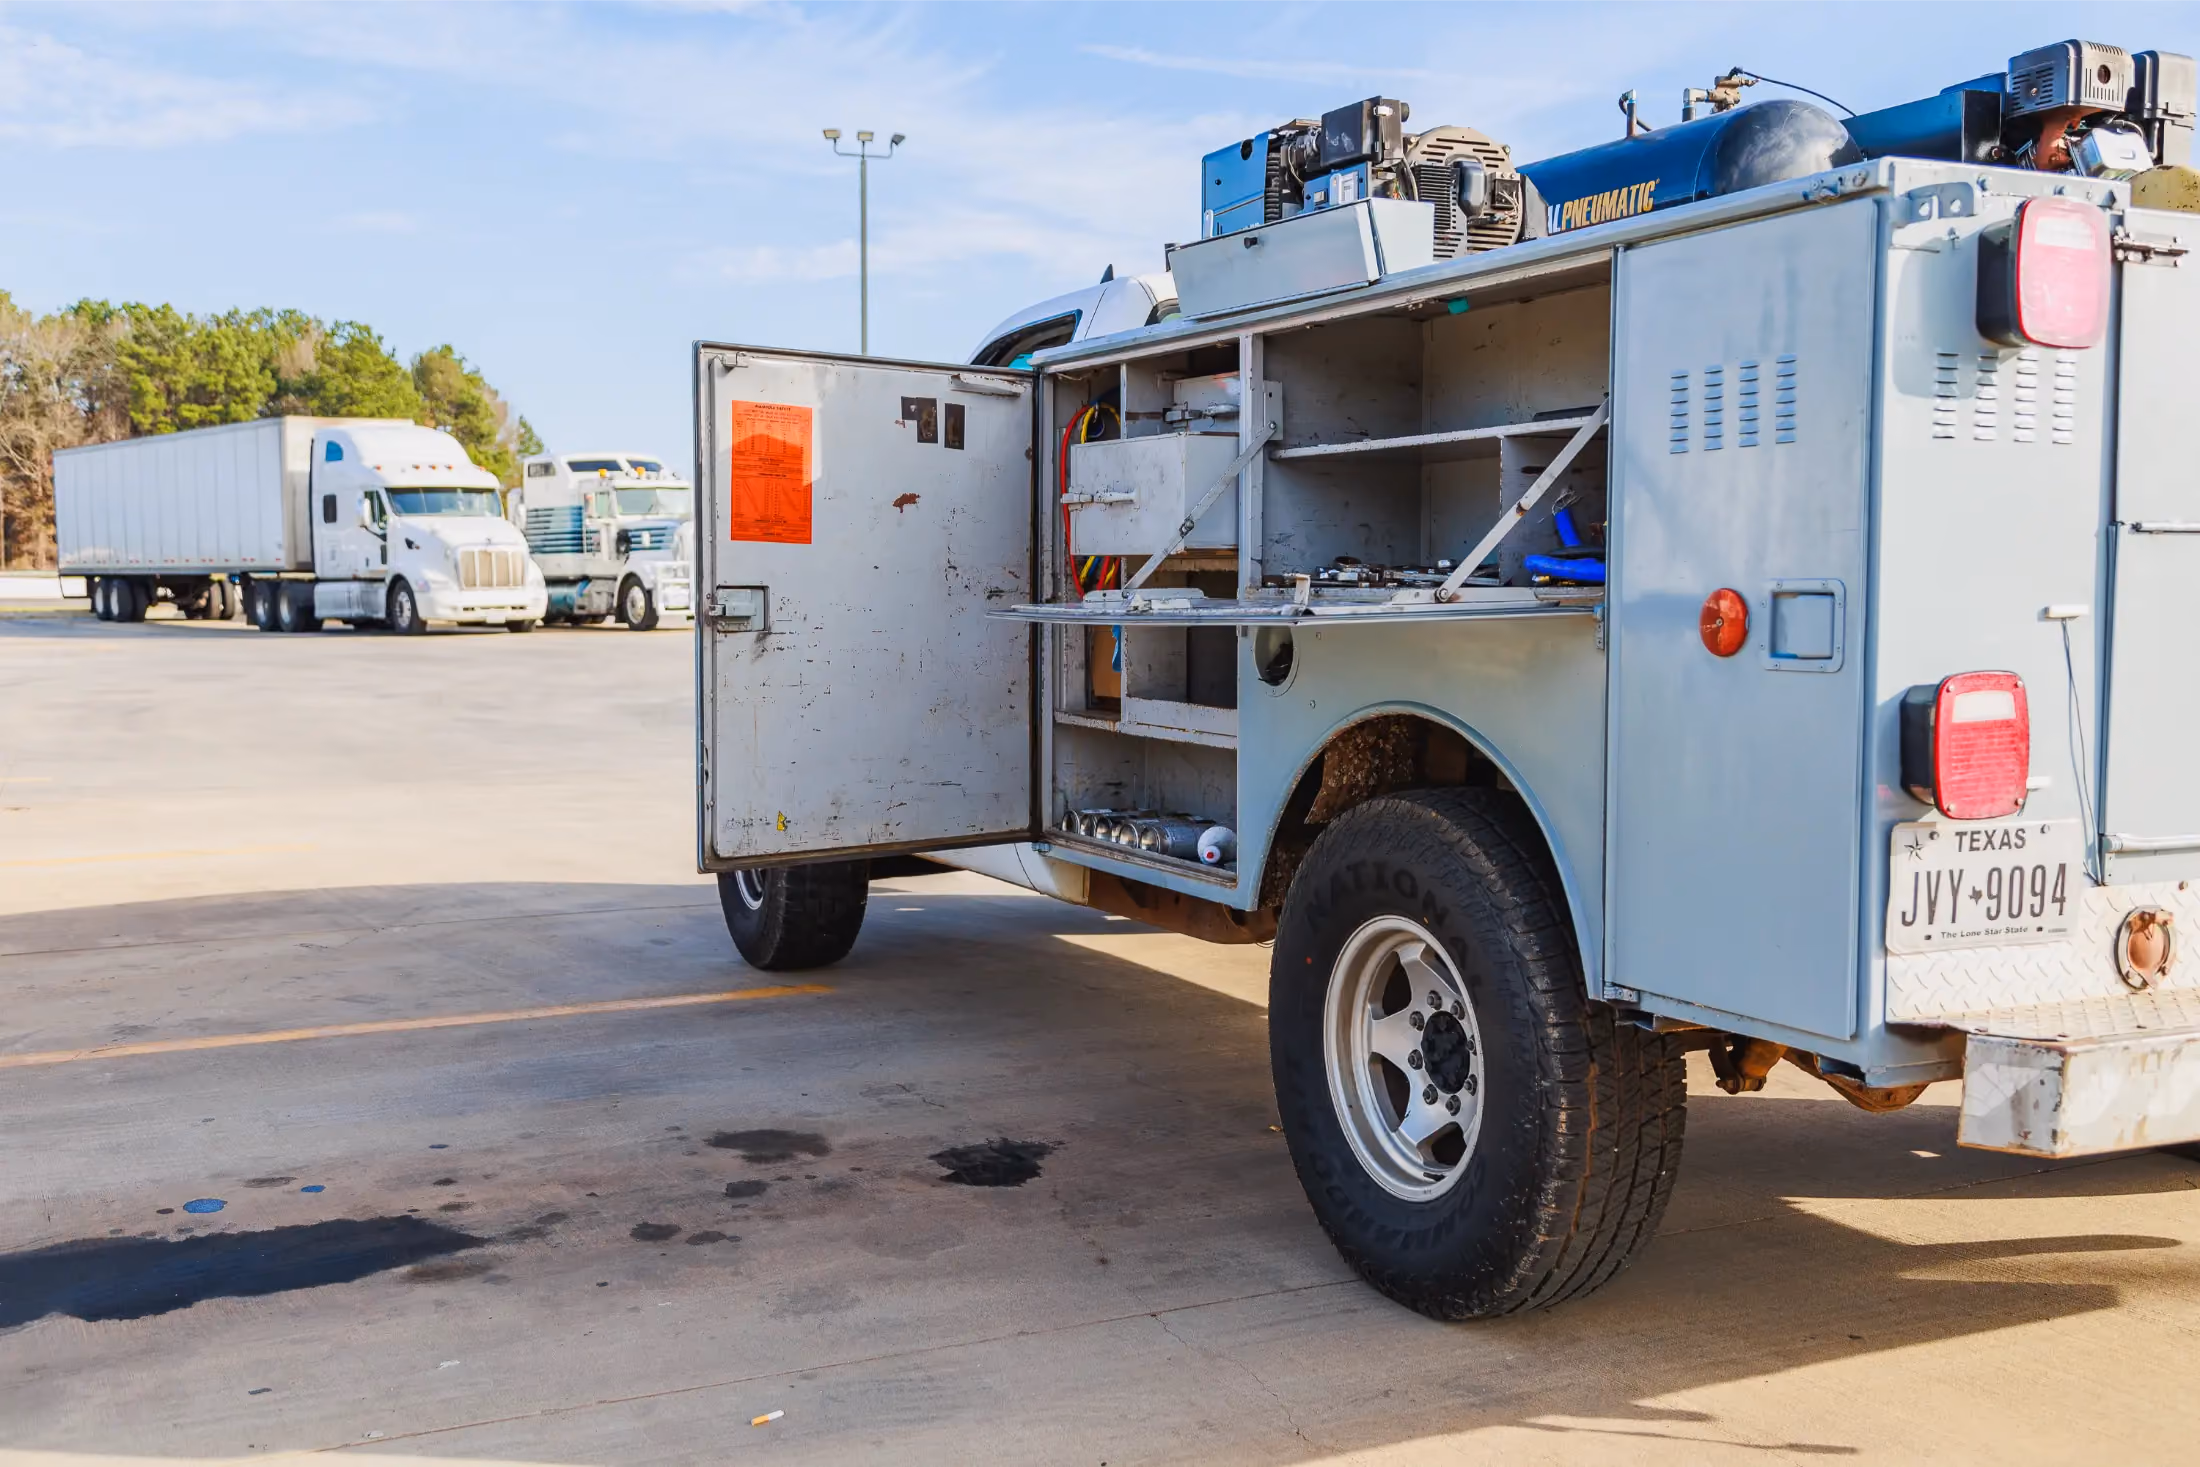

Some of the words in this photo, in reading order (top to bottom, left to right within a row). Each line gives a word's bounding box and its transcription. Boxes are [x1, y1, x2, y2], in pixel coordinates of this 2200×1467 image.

[1955, 828, 2026, 852] TEXAS
[1901, 868, 1964, 927] JVY
[1986, 863, 2066, 920] 9094
[1940, 931, 1957, 939] The
[1960, 928, 1981, 937] Lone
[1984, 927, 2002, 936] Star
[2004, 925, 2028, 934] State
